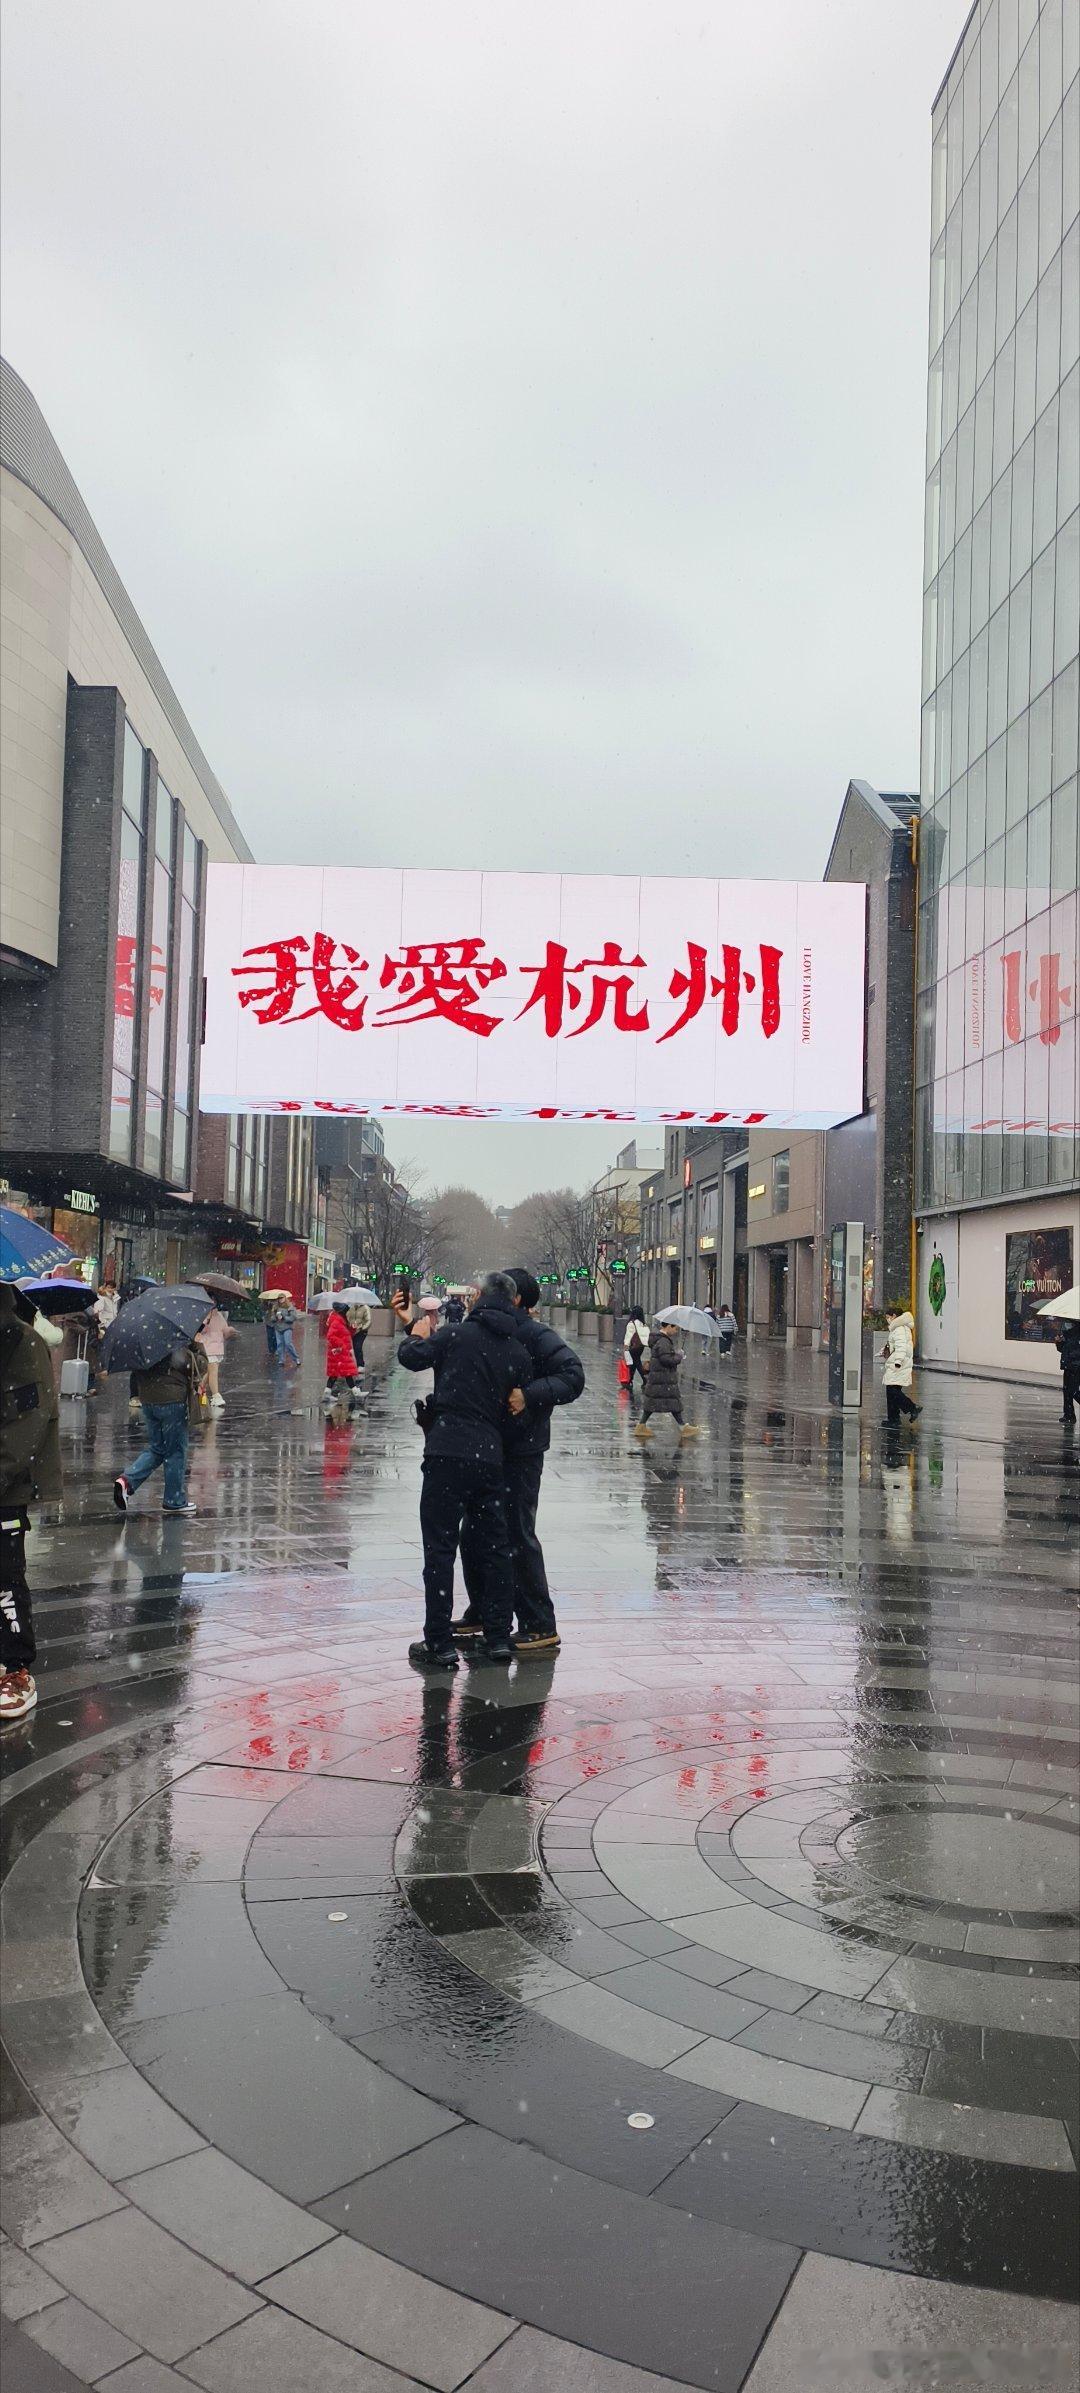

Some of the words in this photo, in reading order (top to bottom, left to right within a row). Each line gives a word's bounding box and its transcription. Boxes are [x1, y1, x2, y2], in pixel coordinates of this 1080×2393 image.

[230, 931, 784, 1045] 我愛杭州
[802, 954, 812, 982] LOVE
[802, 984, 811, 1044] HANGZHOU
[1037, 1278, 1062, 1292] VUITTON
